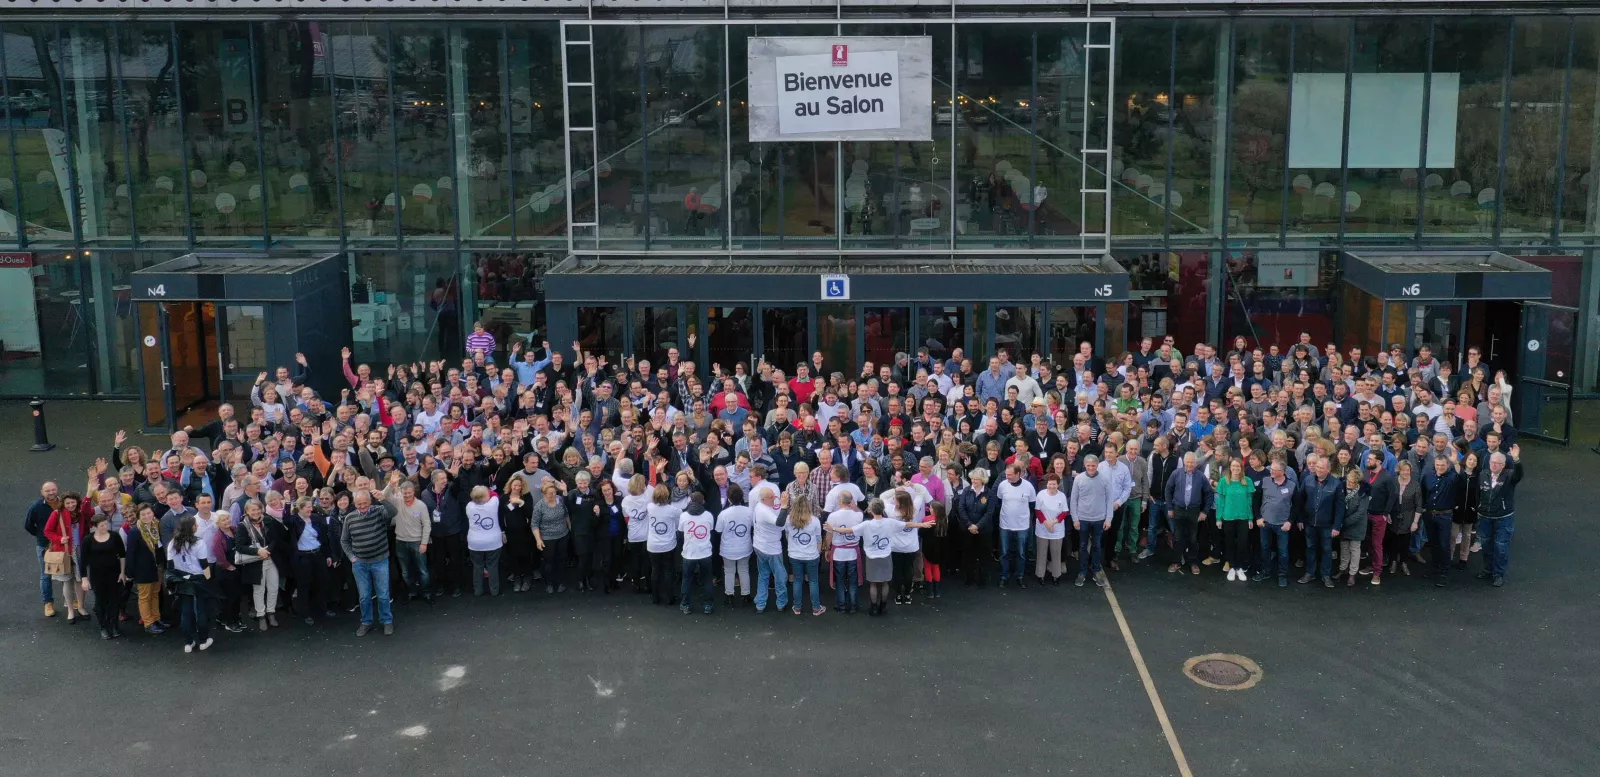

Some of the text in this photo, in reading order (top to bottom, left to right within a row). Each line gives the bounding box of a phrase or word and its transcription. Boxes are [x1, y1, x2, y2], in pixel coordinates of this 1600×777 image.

[784, 71, 892, 92] Bienvenue
[226, 98, 248, 124] B
[794, 95, 884, 117] au Salon
[147, 284, 166, 297] N4
[1094, 284, 1113, 297] N5
[1402, 283, 1421, 296] N6
[473, 513, 494, 530] 20
[650, 516, 668, 535] 20
[688, 520, 708, 539] 20
[728, 520, 747, 537] 20
[872, 535, 889, 550] 20
